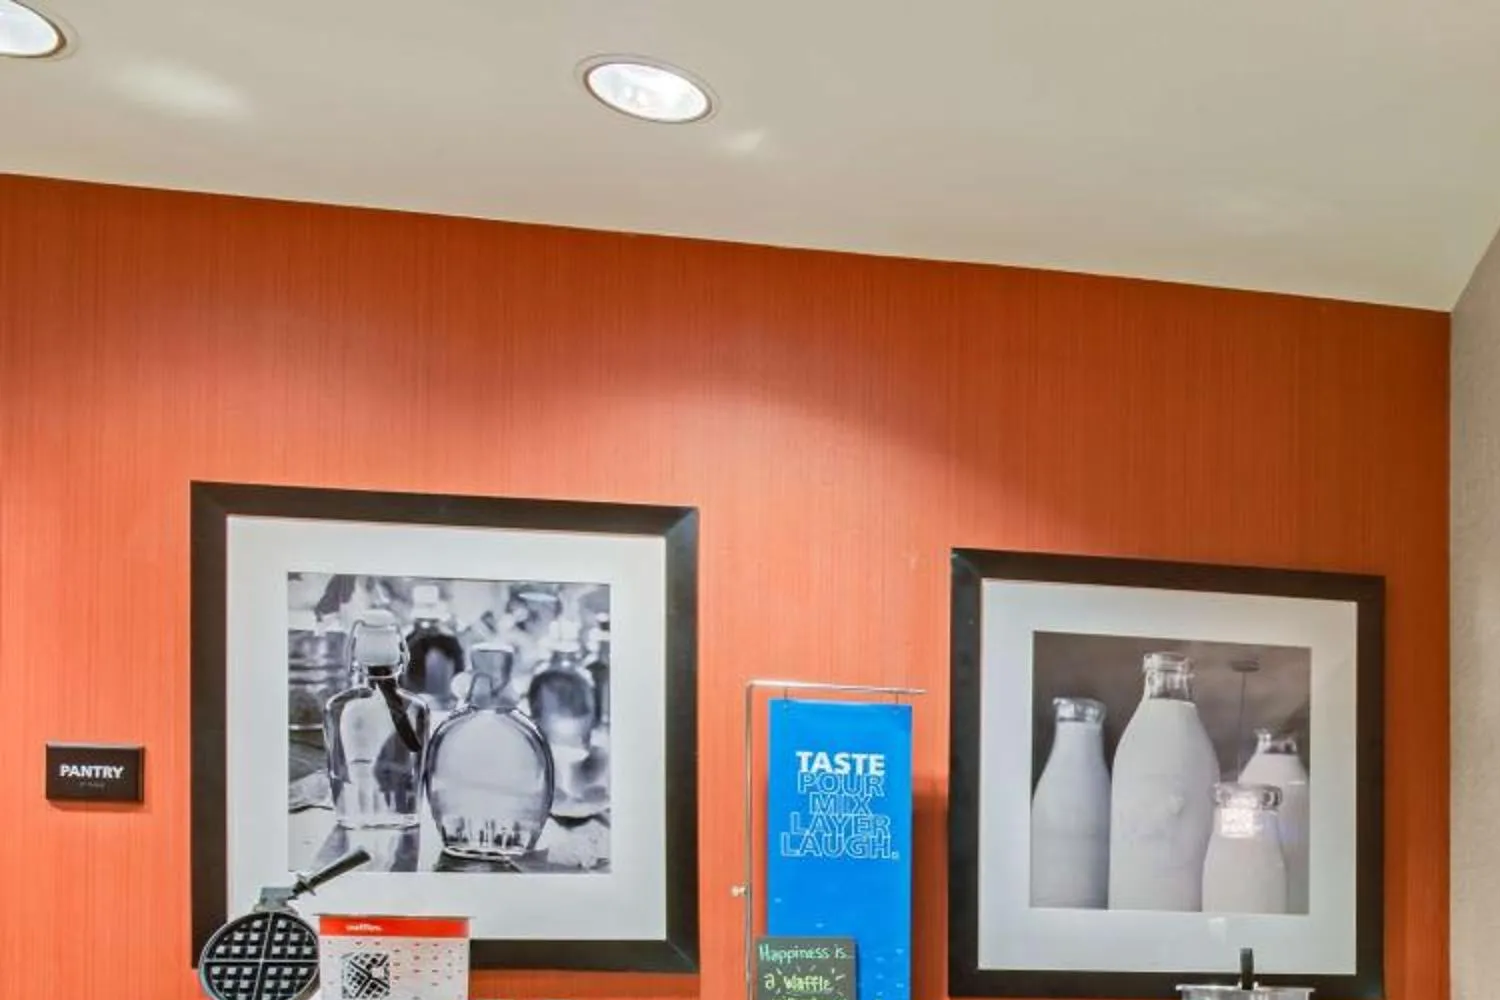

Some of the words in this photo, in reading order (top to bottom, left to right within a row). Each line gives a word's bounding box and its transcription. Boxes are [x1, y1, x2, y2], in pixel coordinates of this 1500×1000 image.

[60, 764, 123, 778] PANTRY
[796, 751, 885, 776] TASTE
[798, 770, 885, 797] POUR
[809, 792, 872, 816] MIX
[790, 811, 891, 837] LAYER
[780, 832, 899, 859] LAUGH.
[758, 943, 830, 964] Happiness
